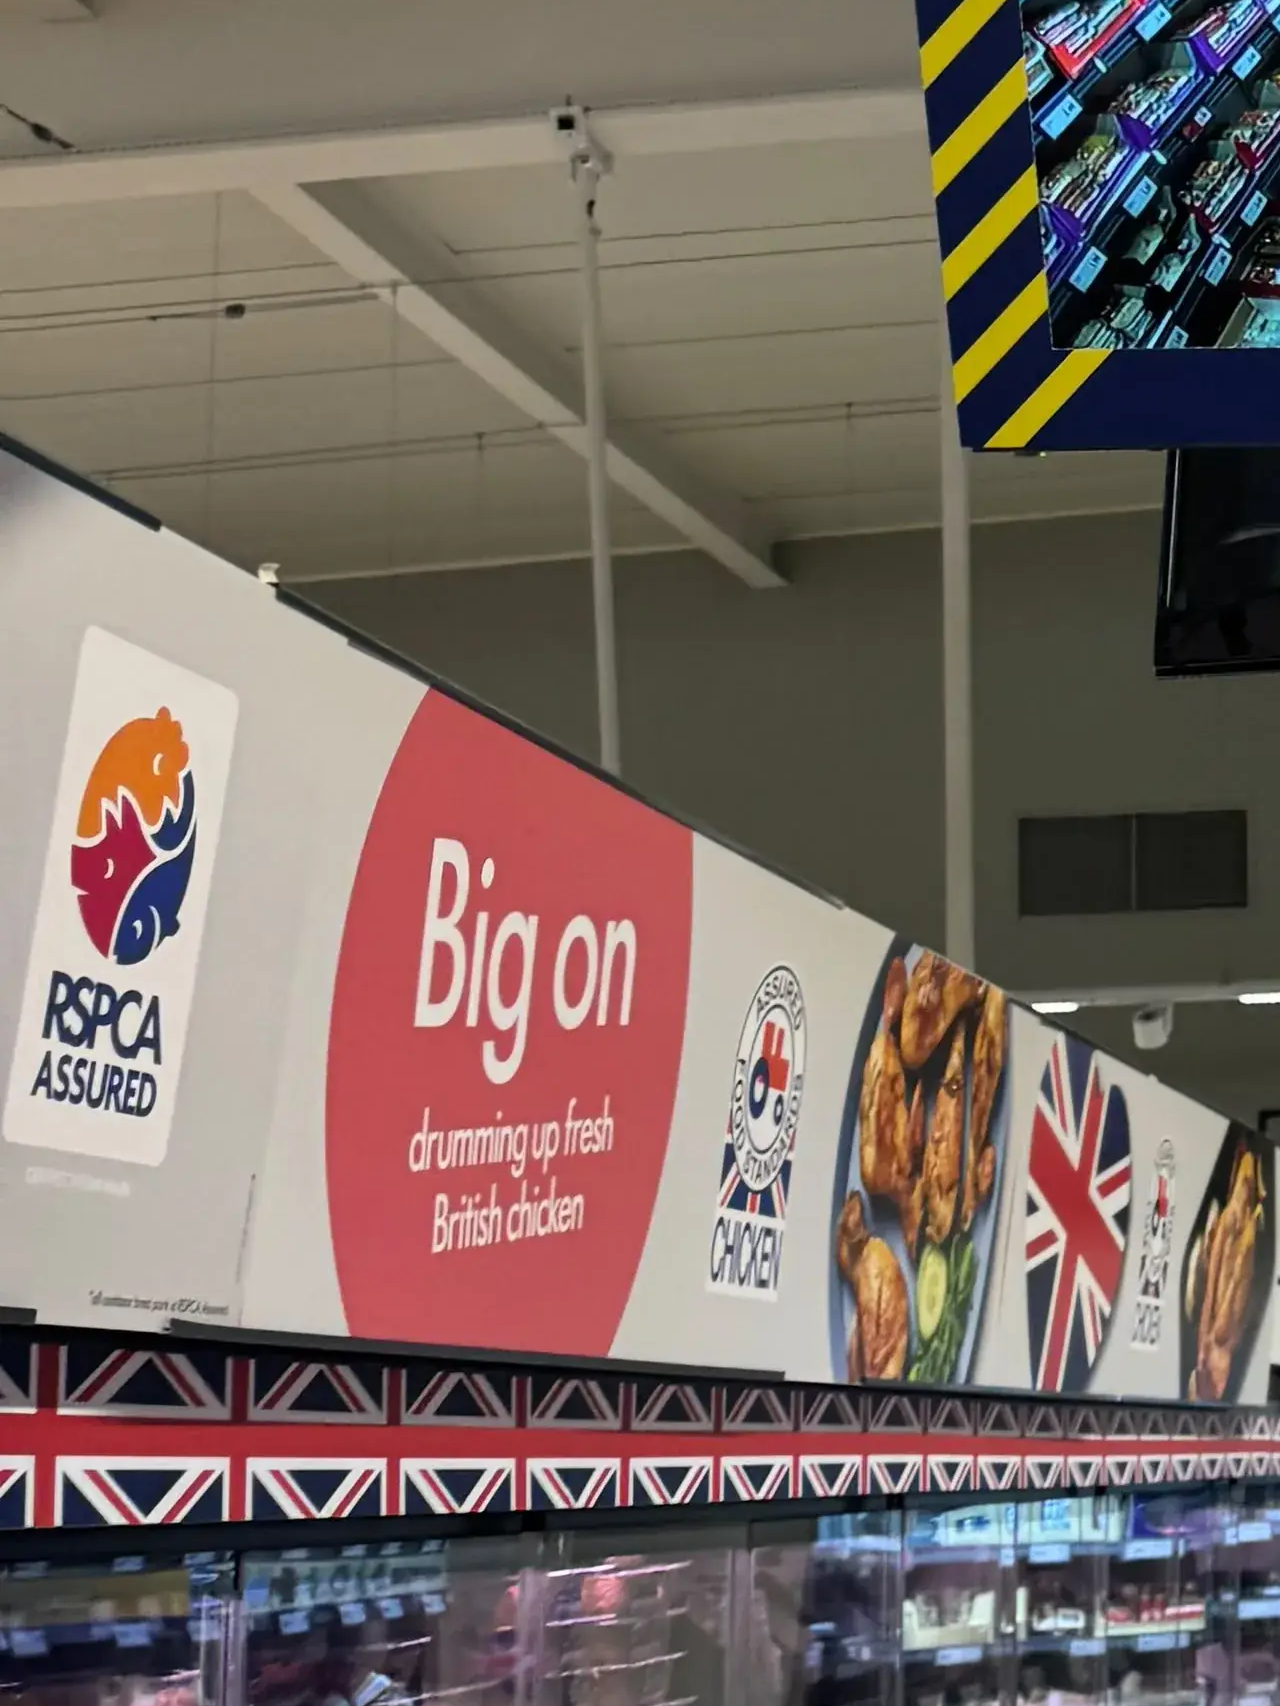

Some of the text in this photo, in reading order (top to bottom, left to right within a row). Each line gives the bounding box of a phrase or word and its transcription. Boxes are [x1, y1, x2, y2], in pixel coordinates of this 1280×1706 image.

[413, 836, 637, 1085] Big on
[41, 970, 162, 1066] RSPCA
[756, 974, 804, 1031] ASSURED
[29, 1050, 158, 1118] ASSURED
[408, 1095, 614, 1179] drumming up fresh
[432, 1175, 585, 1254] British chicken
[710, 1215, 785, 1291] CHICKEN
